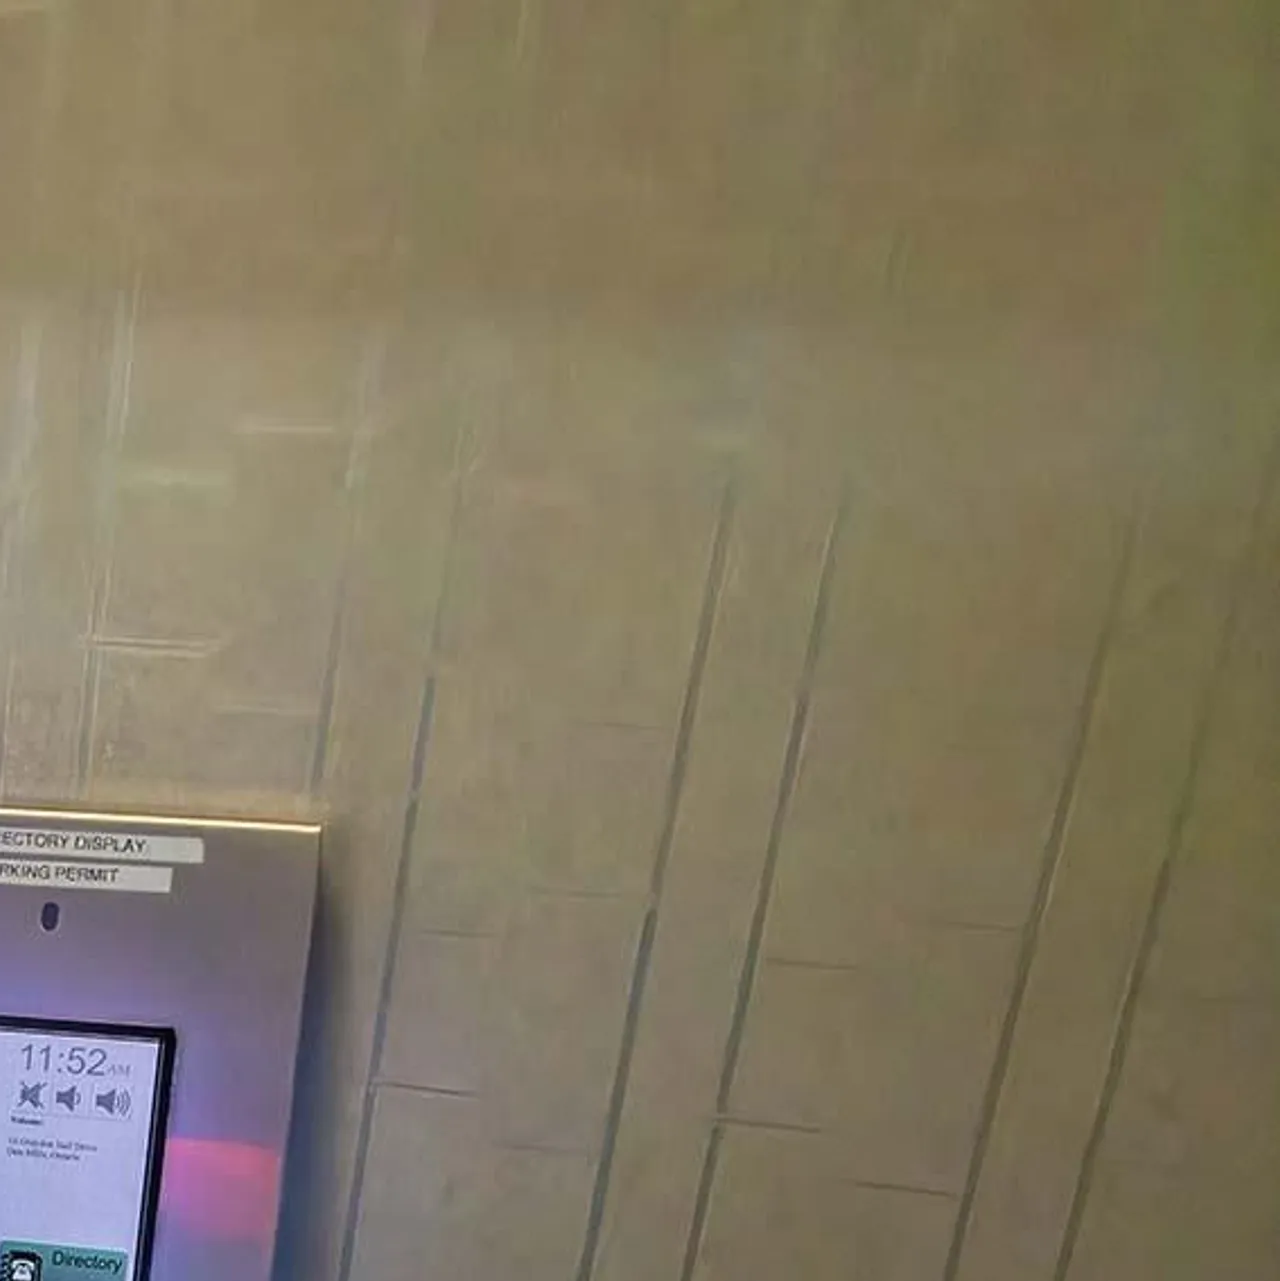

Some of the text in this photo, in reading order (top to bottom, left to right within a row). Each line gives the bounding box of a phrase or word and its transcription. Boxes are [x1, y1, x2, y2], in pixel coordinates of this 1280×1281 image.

[54, 865, 119, 883] PERMIT
[21, 1043, 107, 1077] 11:52
[51, 1249, 123, 1273] Directory
